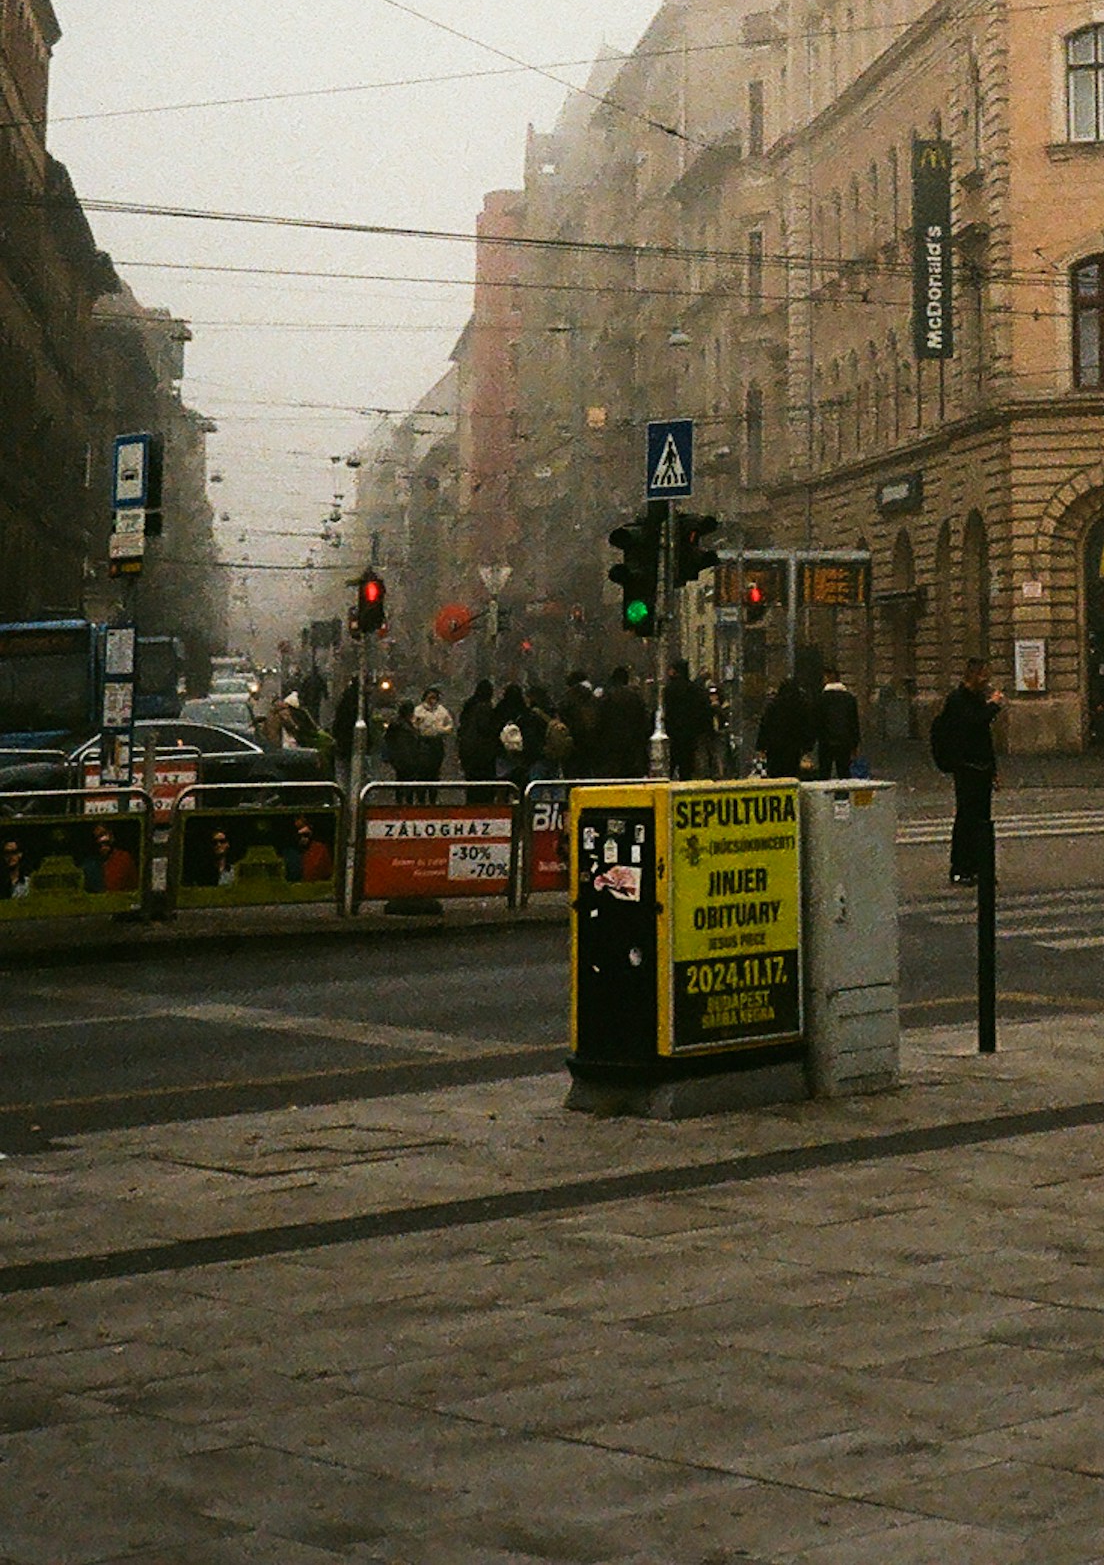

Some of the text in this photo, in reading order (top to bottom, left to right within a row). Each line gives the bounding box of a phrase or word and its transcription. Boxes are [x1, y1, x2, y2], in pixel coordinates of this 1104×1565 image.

[926, 225, 943, 350] McDonald's
[532, 802, 564, 832] Bi
[676, 794, 795, 829] SEPULTURA
[384, 821, 490, 837] ZÁLOGHÁZ
[452, 846, 490, 861] -30%
[470, 862, 508, 878] -70%
[708, 868, 767, 897] JINJER
[694, 901, 781, 931] OBITUARY
[686, 956, 788, 994] 2024.11.17.
